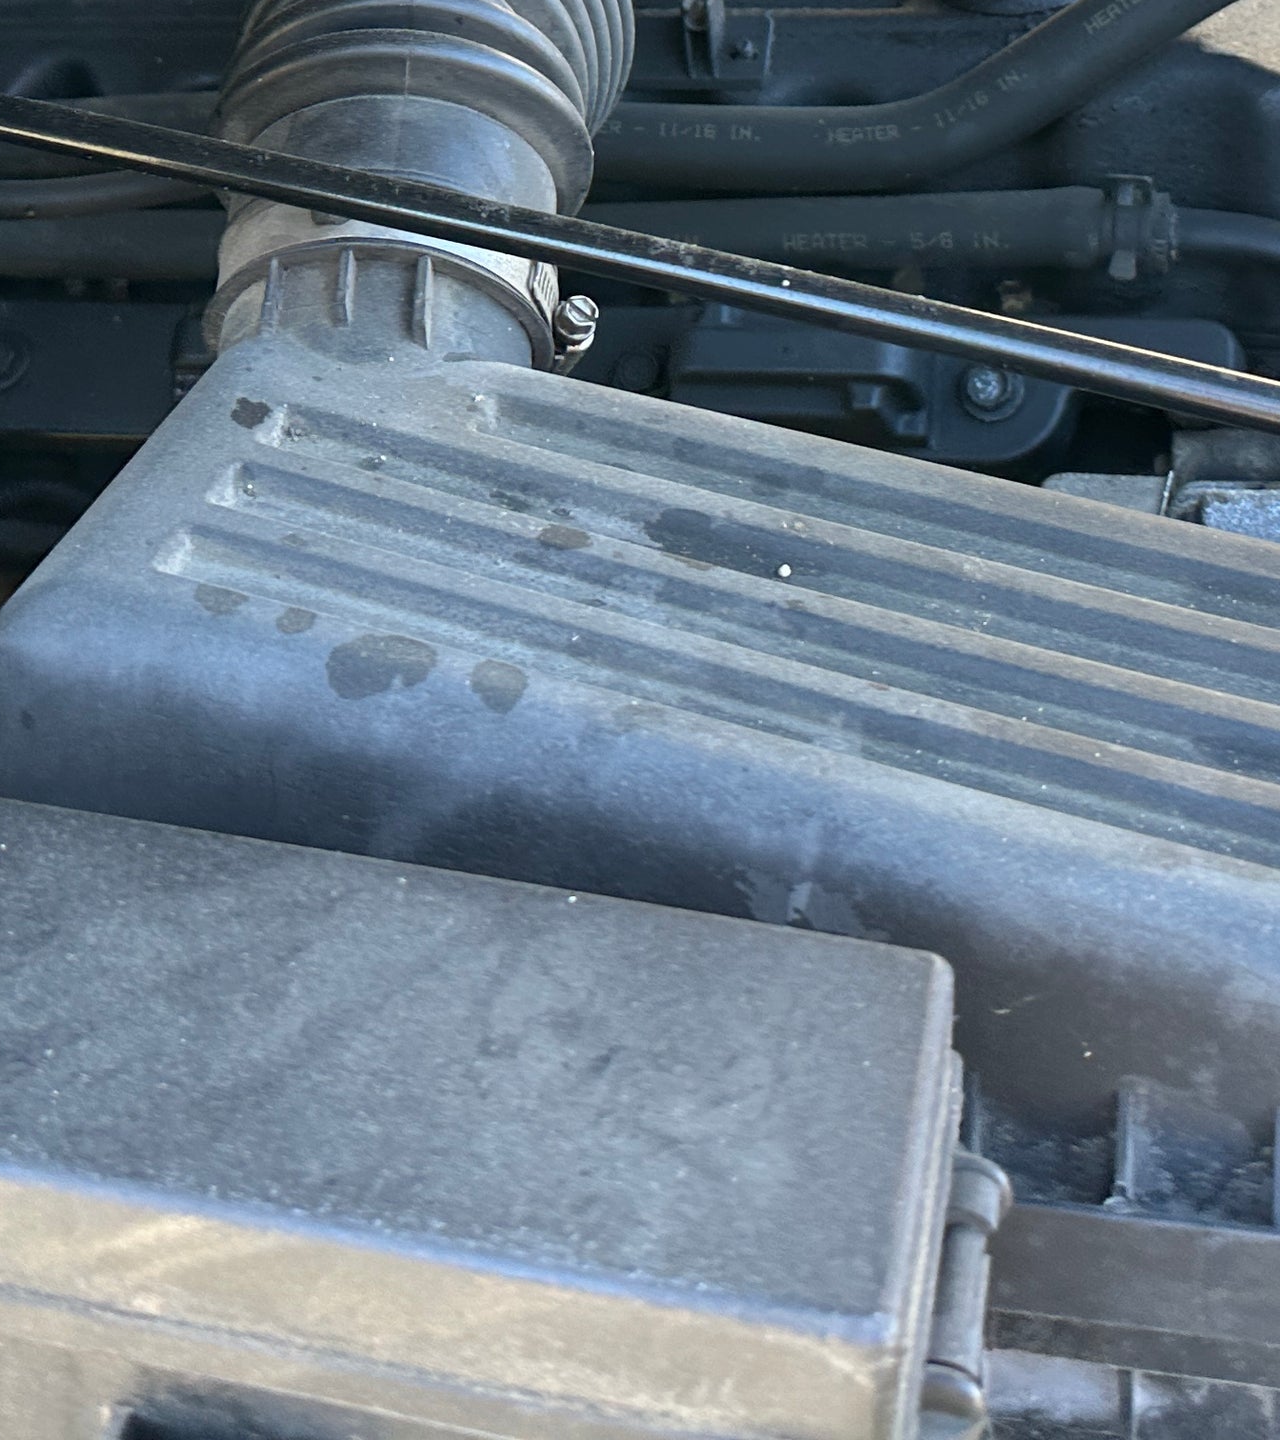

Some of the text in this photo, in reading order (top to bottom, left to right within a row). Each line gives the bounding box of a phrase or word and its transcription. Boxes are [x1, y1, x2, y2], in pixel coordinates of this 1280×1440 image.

[826, 124, 900, 144] HEATER
[998, 68, 1029, 92] IN.
[782, 231, 868, 251] HEATER
[972, 231, 1010, 250] IN.
